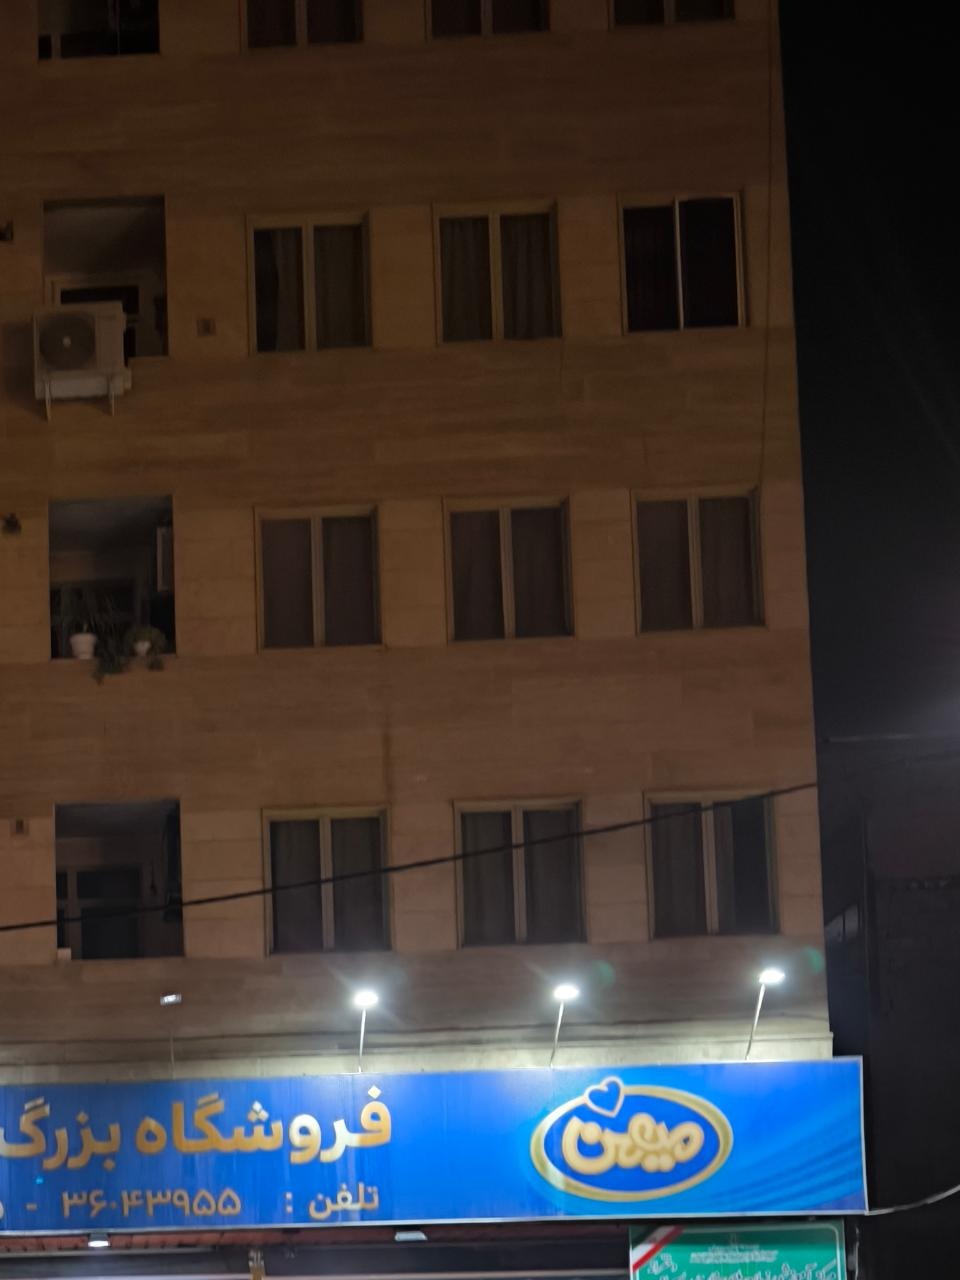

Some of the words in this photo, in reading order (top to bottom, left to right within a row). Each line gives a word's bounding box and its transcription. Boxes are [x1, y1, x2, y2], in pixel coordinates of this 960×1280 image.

[134, 1085, 393, 1165] فروشگاه
[561, 1112, 705, 1176] میهن
[61, 1187, 242, 1218] ۳۶۰۴۳۹۵۵
[308, 1182, 380, 1220] تلفن
